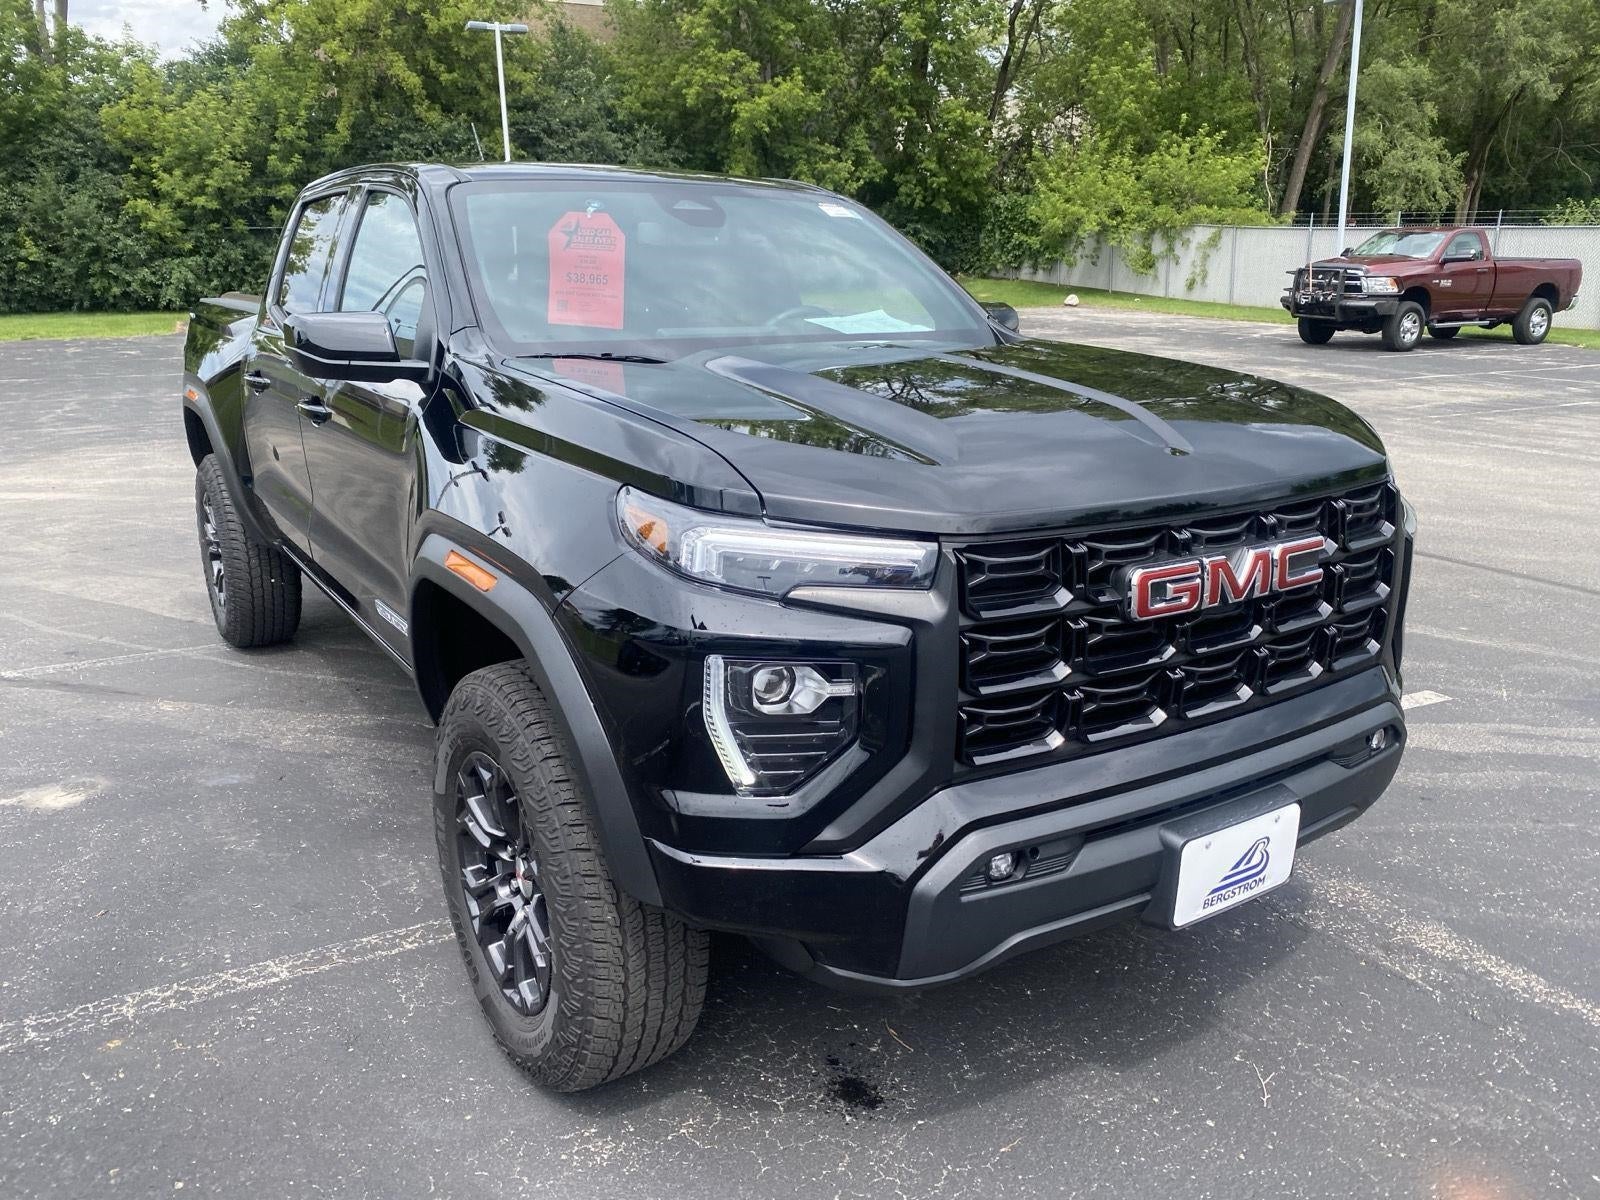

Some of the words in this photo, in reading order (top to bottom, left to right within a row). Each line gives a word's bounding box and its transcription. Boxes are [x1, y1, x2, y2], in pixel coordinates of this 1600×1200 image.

[566, 271, 608, 285] $38,965
[1131, 536, 1325, 620] GMC
[1202, 875, 1266, 910] BERGSTROM
